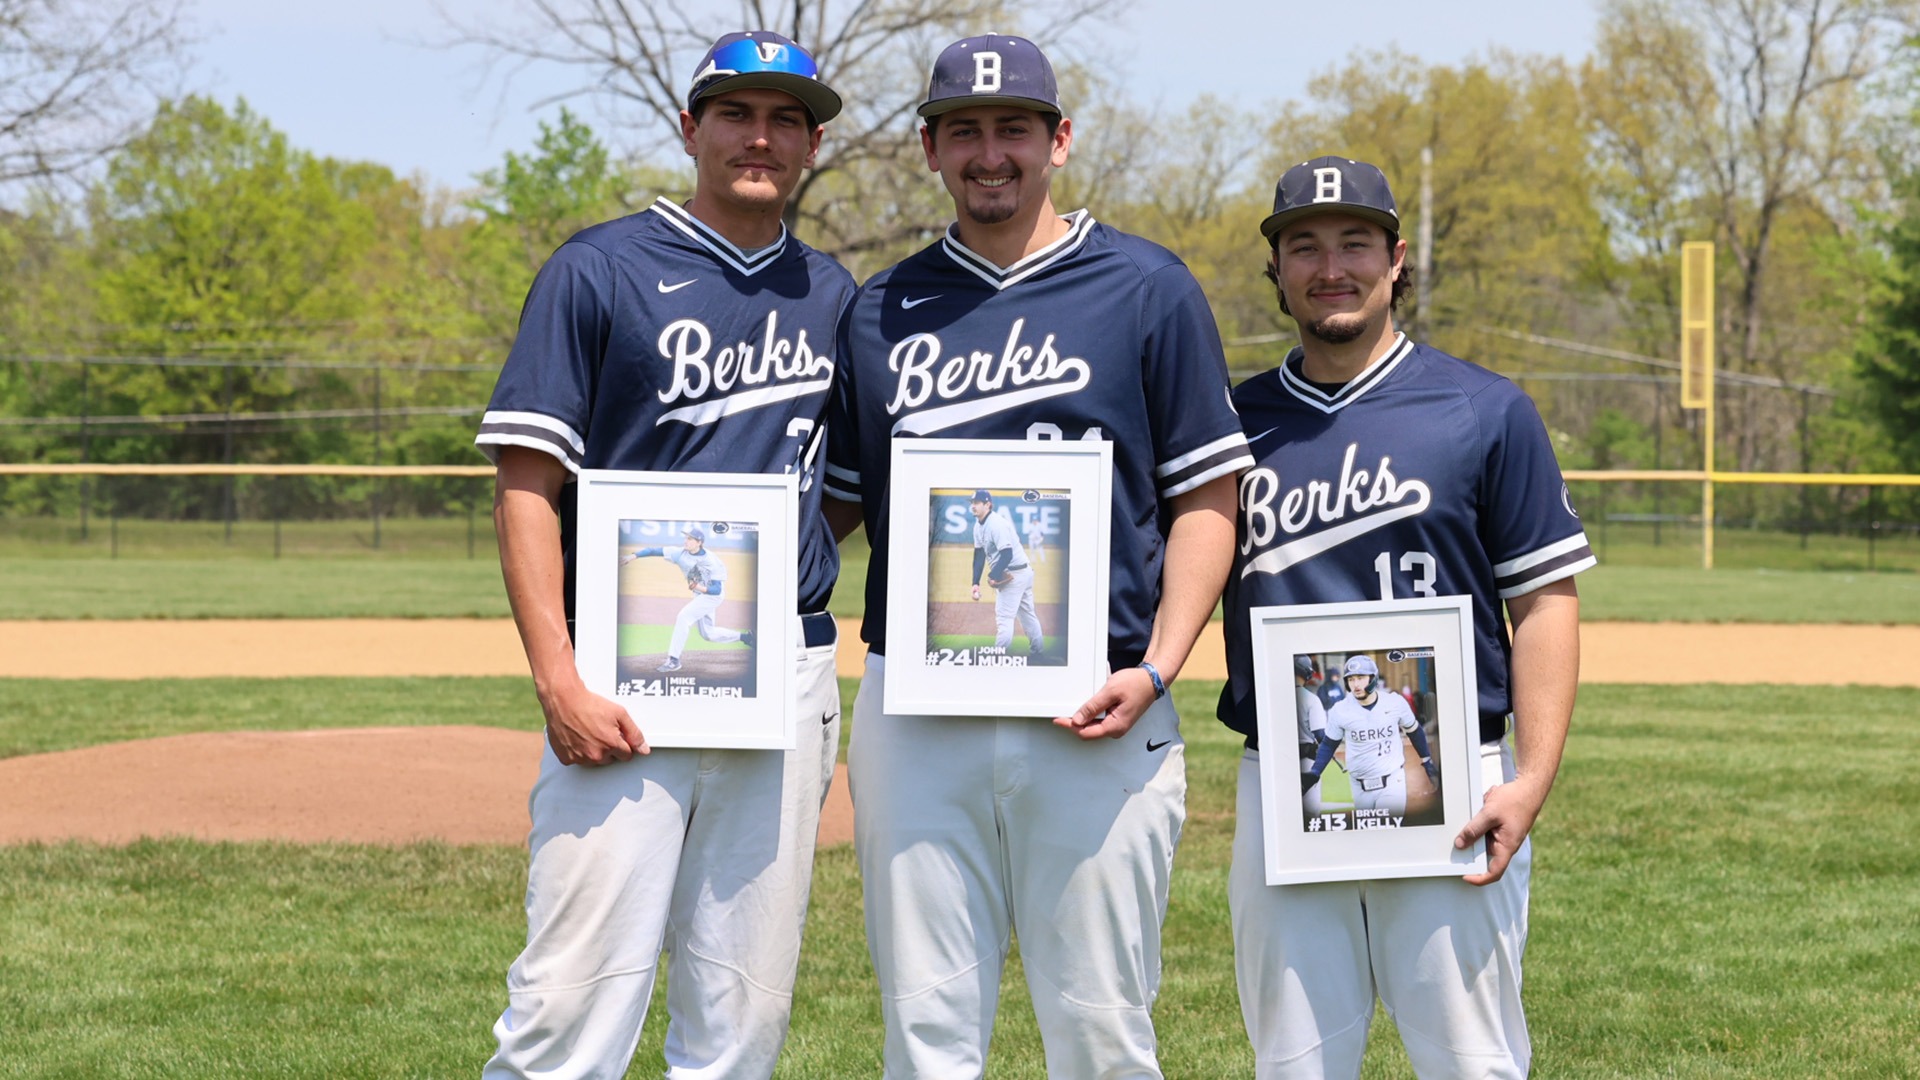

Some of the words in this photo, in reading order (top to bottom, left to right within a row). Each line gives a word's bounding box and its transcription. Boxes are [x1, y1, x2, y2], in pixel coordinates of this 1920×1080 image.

[972, 51, 1001, 93] B
[1313, 167, 1342, 203] B
[658, 311, 834, 404] Berks
[886, 318, 1090, 415] Berks
[1239, 443, 1431, 556] Berks
[1374, 551, 1437, 601] 13
[926, 648, 972, 666] #24
[978, 646, 1006, 655] JOHN
[978, 655, 1027, 667] MUDRI
[618, 678, 663, 696] #34
[669, 677, 696, 686] MIKE
[669, 686, 742, 698] KELEMEN
[1351, 725, 1393, 741] BERKS
[1355, 808, 1390, 818] BRYCE
[1308, 813, 1347, 832] #13
[1356, 816, 1403, 830] KELLY
